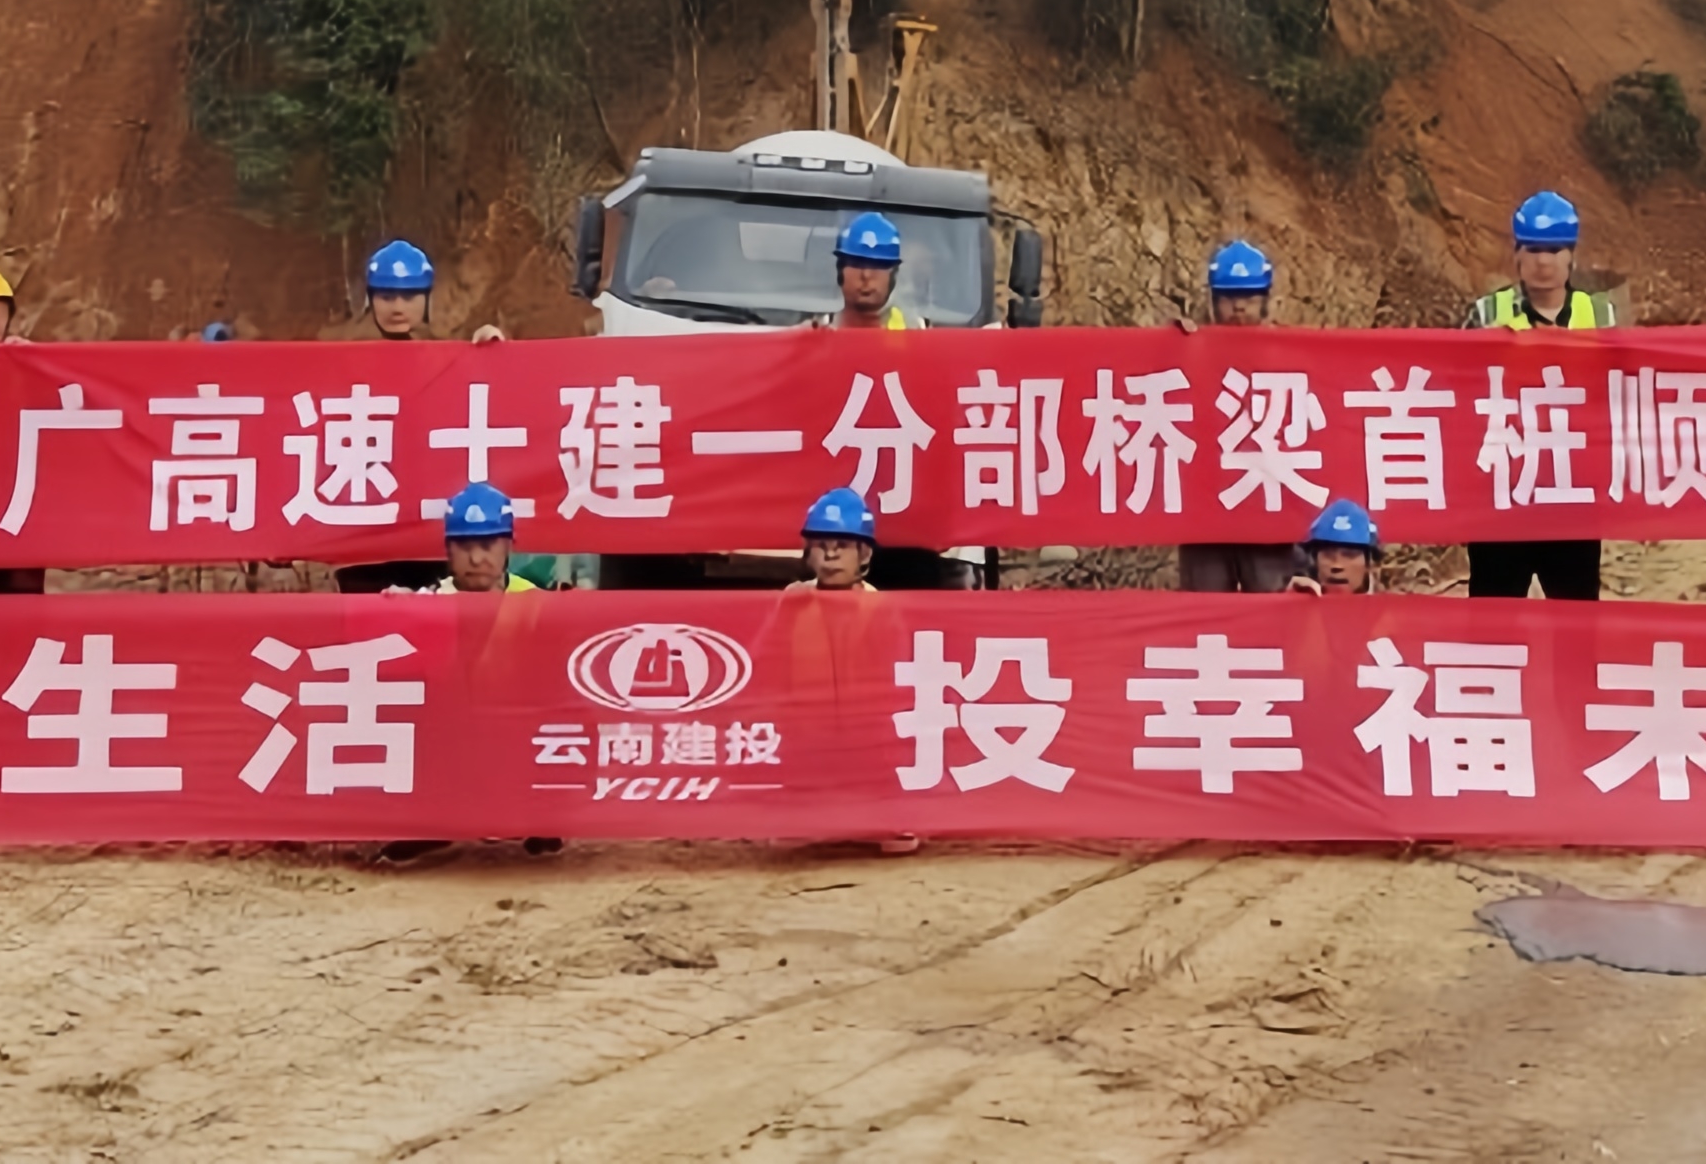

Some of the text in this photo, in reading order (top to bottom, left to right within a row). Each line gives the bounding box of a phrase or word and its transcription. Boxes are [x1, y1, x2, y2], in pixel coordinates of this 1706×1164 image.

[531, 721, 782, 766] 云南建投
[592, 777, 720, 801] YCIH
